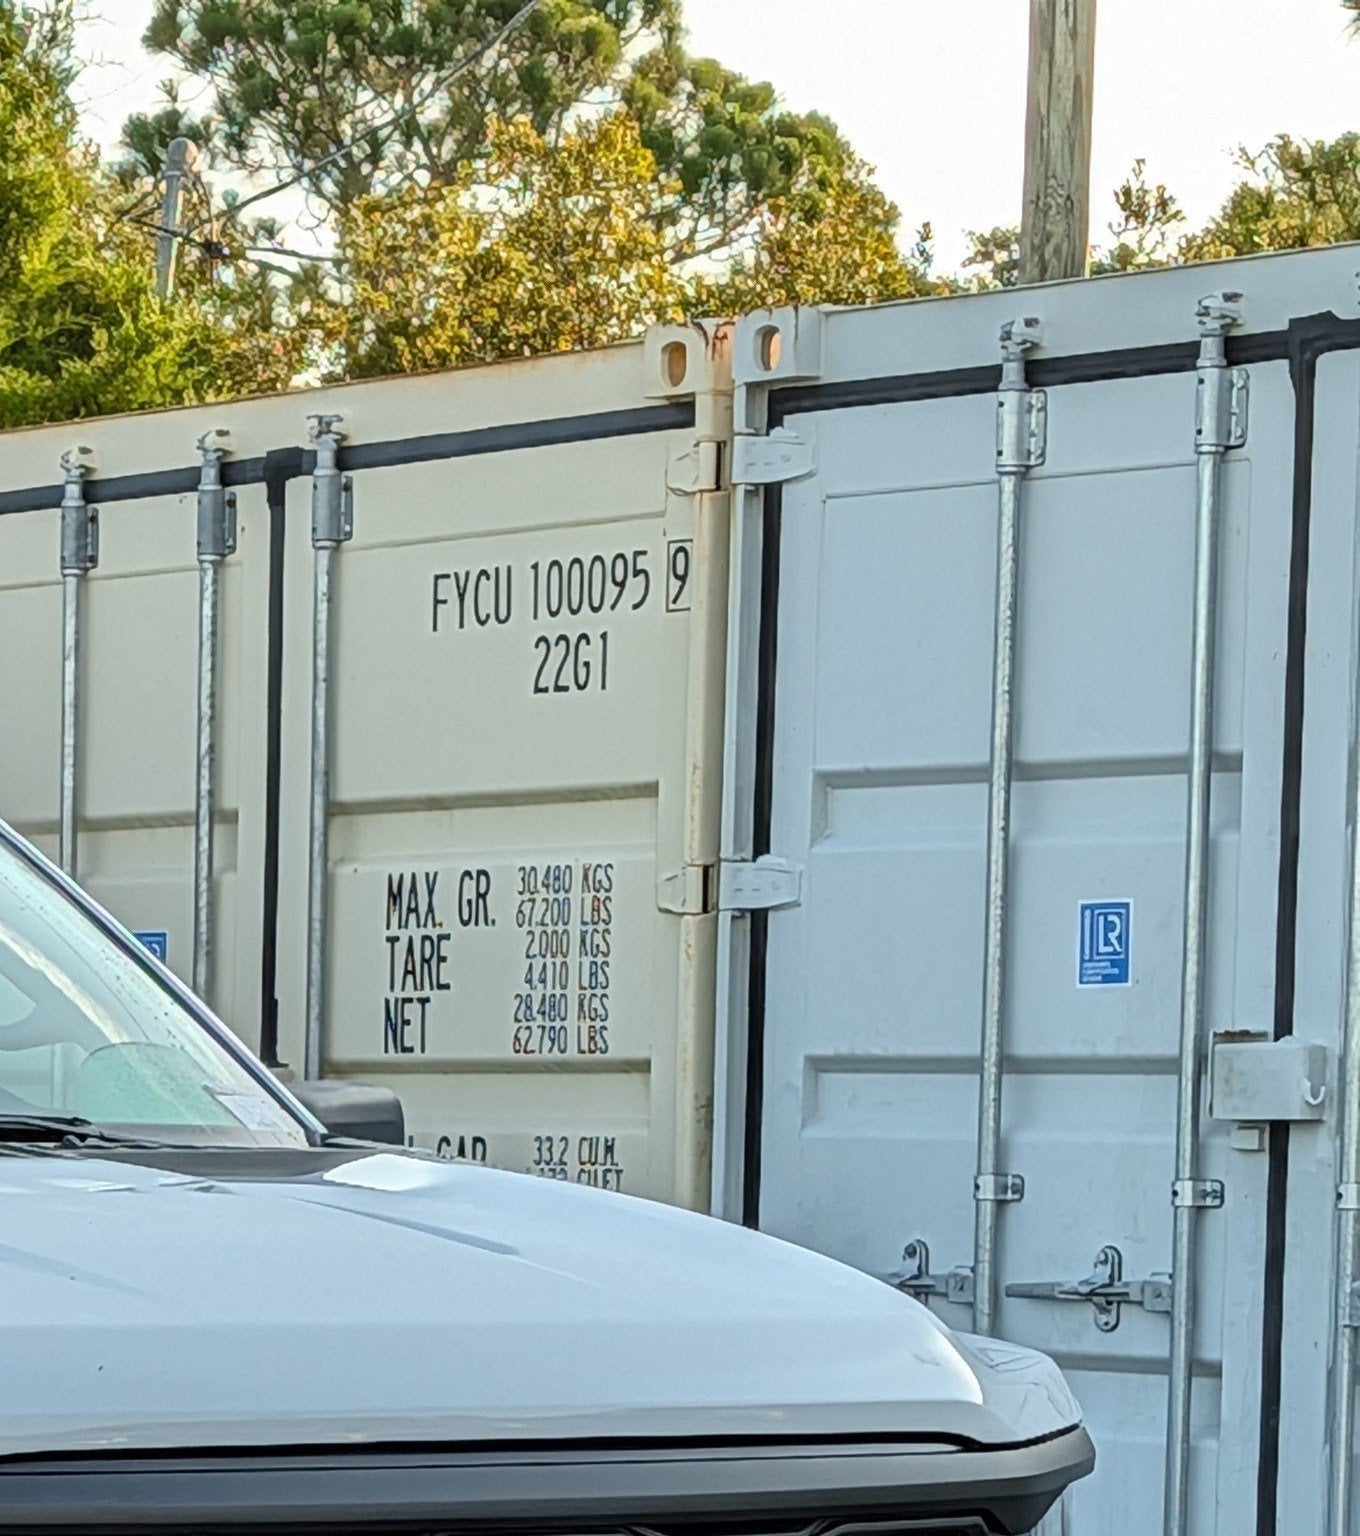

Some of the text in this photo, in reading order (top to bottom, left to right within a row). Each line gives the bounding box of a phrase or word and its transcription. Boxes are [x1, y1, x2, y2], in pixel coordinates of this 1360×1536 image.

[432, 545, 690, 633] FYCU 100095 9
[533, 630, 609, 695] 22G1
[517, 862, 615, 896] 30.480 KGS
[457, 868, 496, 928] GR.
[516, 894, 613, 928] 67.200 LBS
[579, 927, 611, 959] KGS
[385, 932, 452, 992] TARE
[578, 960, 610, 991] LBS
[577, 992, 610, 1023] KGS
[383, 996, 432, 1054] NET
[577, 1024, 610, 1055] LBS
[533, 1135, 569, 1167] 33.2
